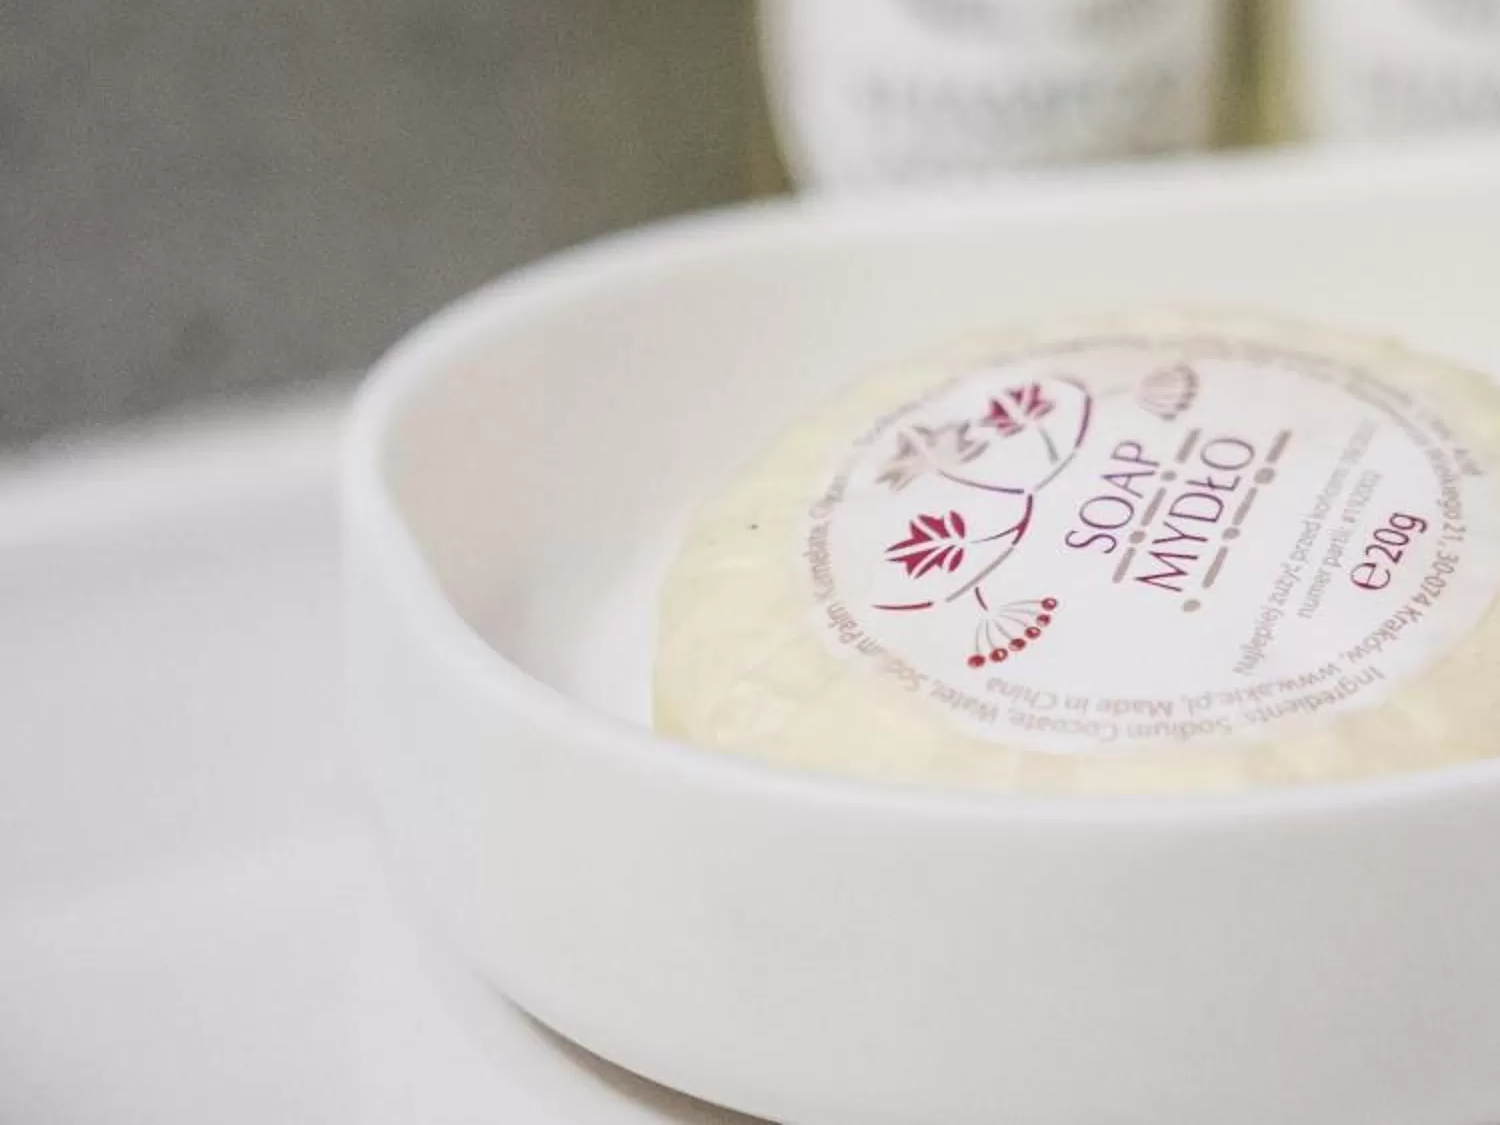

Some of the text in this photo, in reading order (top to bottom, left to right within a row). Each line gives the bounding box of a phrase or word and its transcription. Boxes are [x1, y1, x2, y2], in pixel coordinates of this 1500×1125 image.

[1065, 440, 1160, 554] SOAP
[1134, 437, 1255, 592] MYDŁO
[1411, 548, 1461, 607] 30-074
[985, 677, 1059, 712] China
[1064, 697, 1090, 717] in
[1095, 698, 1174, 719] Made
[1127, 717, 1233, 743] Sodium
